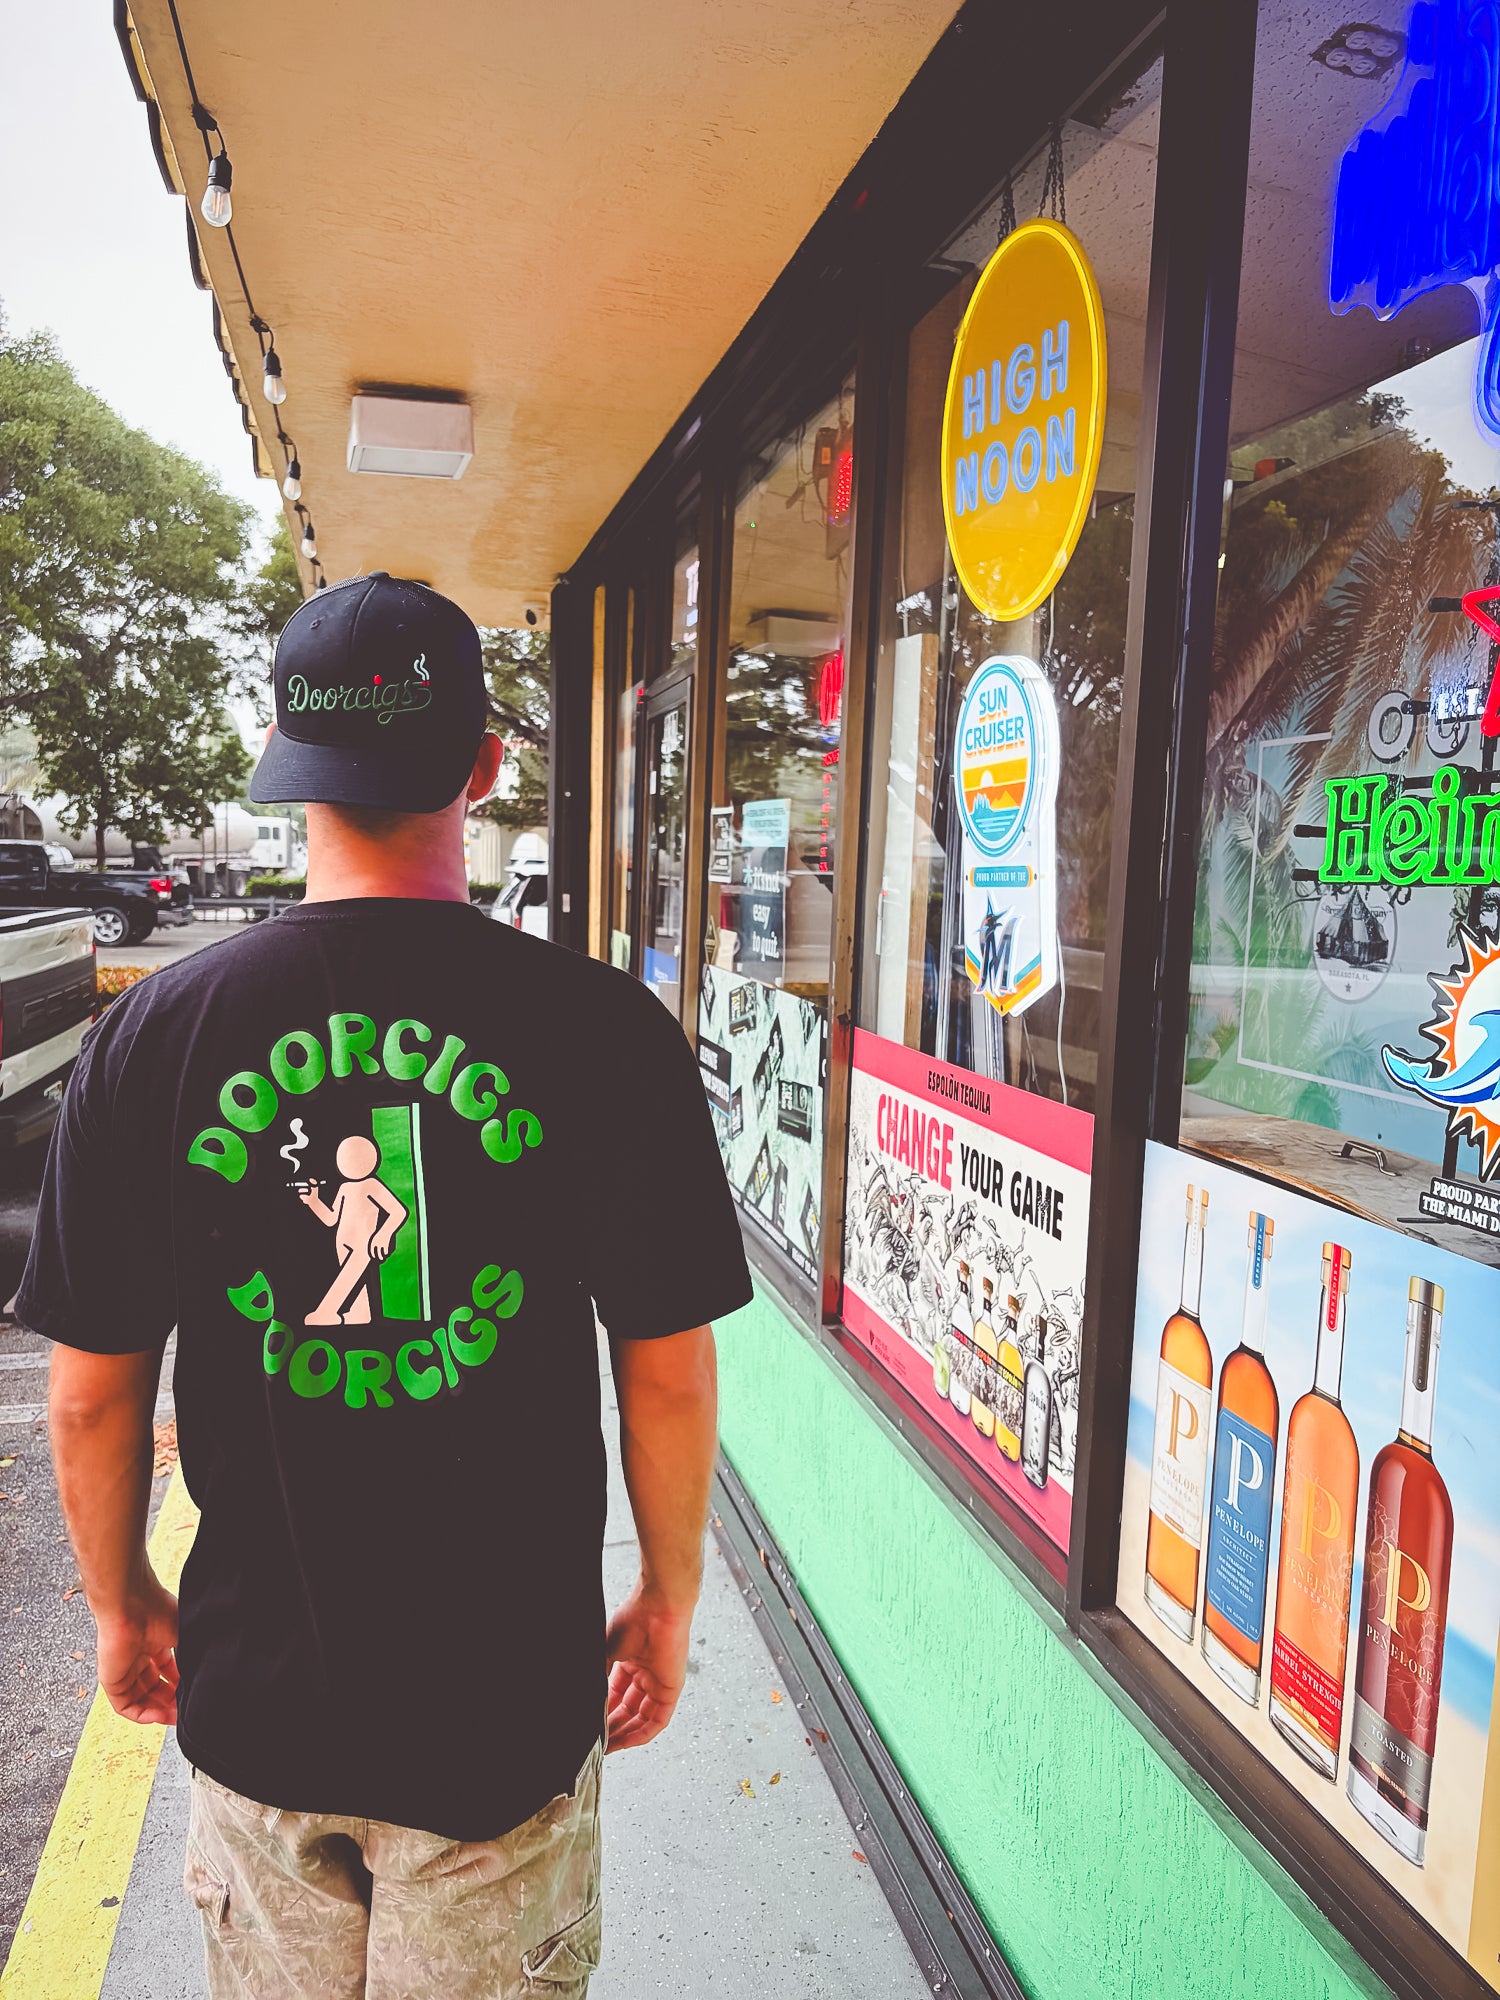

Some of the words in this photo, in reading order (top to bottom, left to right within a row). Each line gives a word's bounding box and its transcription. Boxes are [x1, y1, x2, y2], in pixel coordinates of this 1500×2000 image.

[962, 319, 1070, 439] HIGH
[955, 407, 1075, 515] NOON
[287, 674, 432, 725] Doorcigs
[979, 685, 1008, 720] SUN
[965, 716, 1025, 754] CRUISER
[990, 871, 1009, 882] PARTNER
[1010, 871, 1016, 881] OF
[1017, 870, 1026, 881] THE
[752, 903, 771, 929] easy
[187, 1013, 544, 1184] DOORCIGS
[960, 1082, 991, 1115] TEQUILA
[876, 1093, 954, 1192] CHANGE
[960, 1142, 1004, 1208] YOUR
[1010, 1170, 1064, 1242] GAME
[1422, 1196, 1446, 1216] THE
[1447, 1203, 1489, 1229] MIAMI
[1433, 1181, 1473, 1205] PROUD
[1474, 1193, 1500, 1214] PAR
[1166, 1387, 1199, 1464] P
[1156, 1456, 1200, 1497] PENELOPE
[1222, 1430, 1264, 1515] P
[1215, 1504, 1265, 1552] PENELOPE
[1297, 1477, 1342, 1565] P
[1222, 1535, 1253, 1563] ARCHITECT
[1376, 1539, 1432, 1638] P
[1366, 1623, 1433, 1686] PENELOPE
[1370, 1724, 1413, 1767] TOASTED
